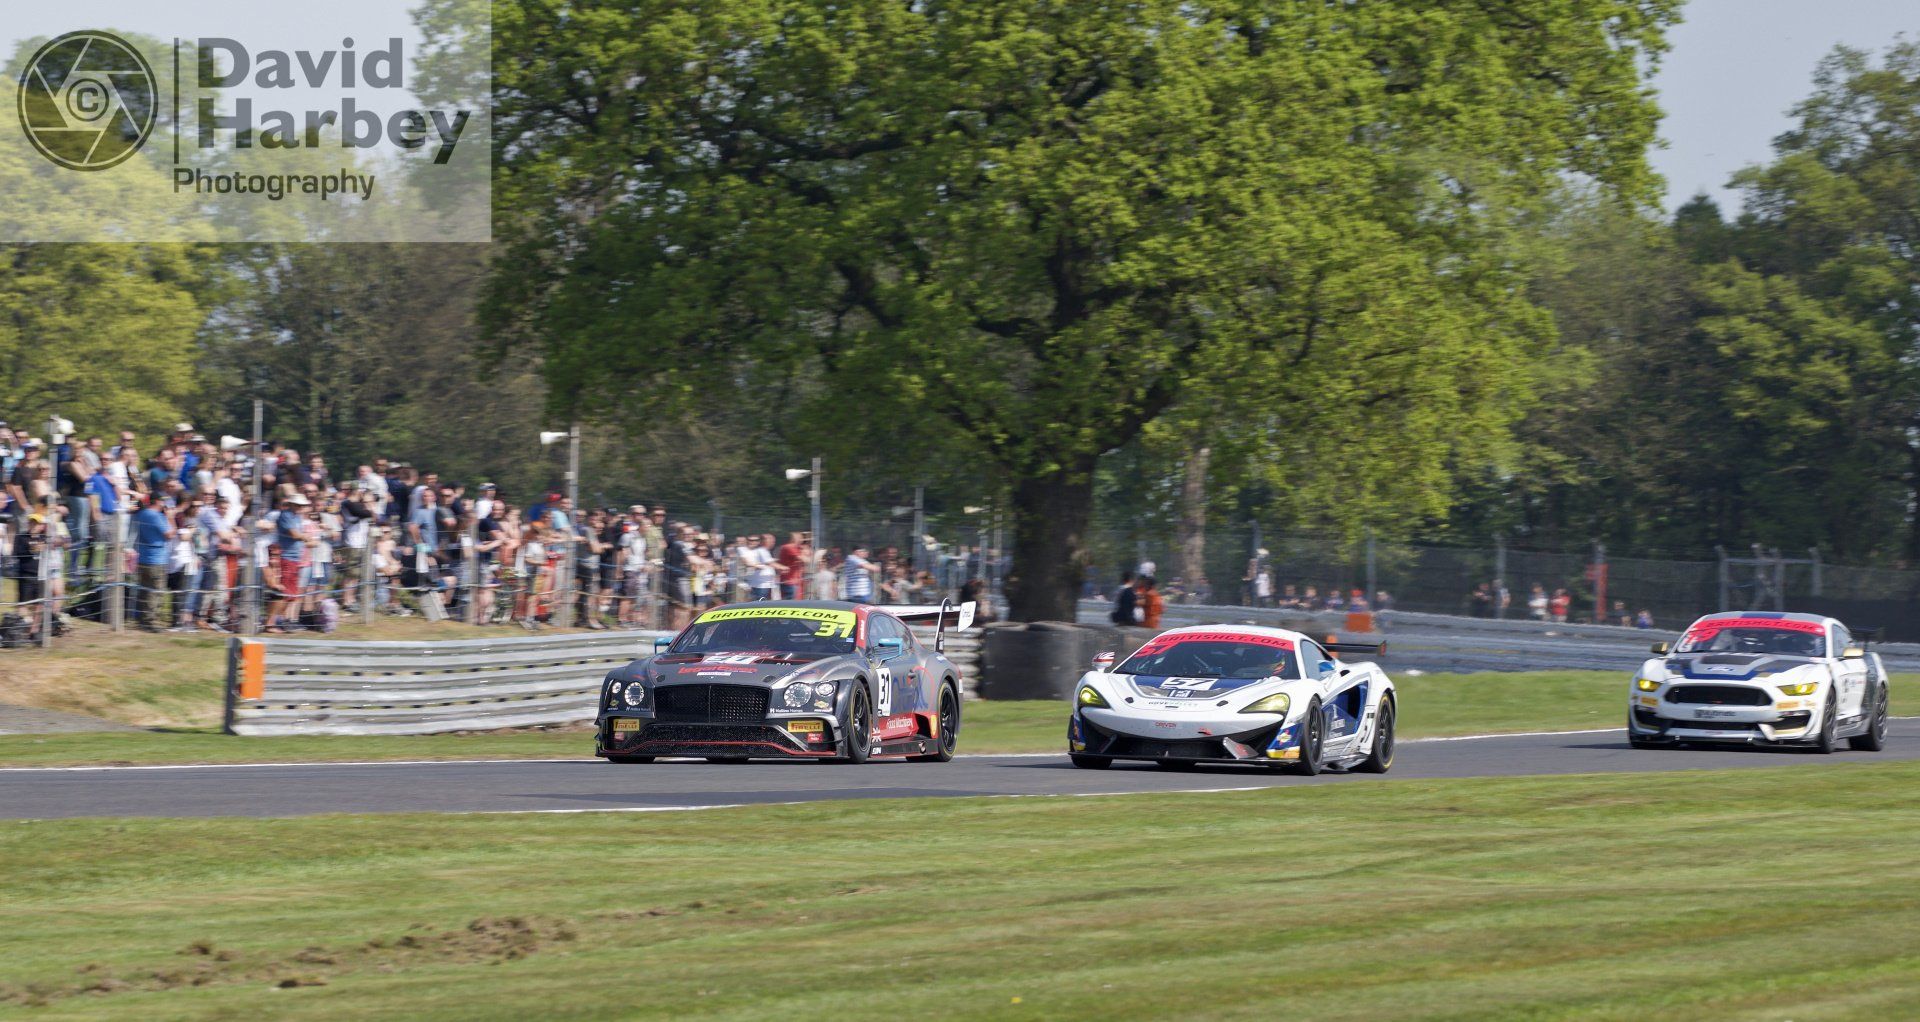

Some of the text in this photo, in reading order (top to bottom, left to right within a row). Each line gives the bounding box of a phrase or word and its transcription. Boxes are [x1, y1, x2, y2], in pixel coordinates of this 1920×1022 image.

[710, 608, 839, 621] BRITISHGT.COM
[814, 622, 855, 638] 31
[1156, 632, 1288, 647] BRITISHGT.COM
[880, 673, 890, 705] 31
[1163, 678, 1215, 687] 57
